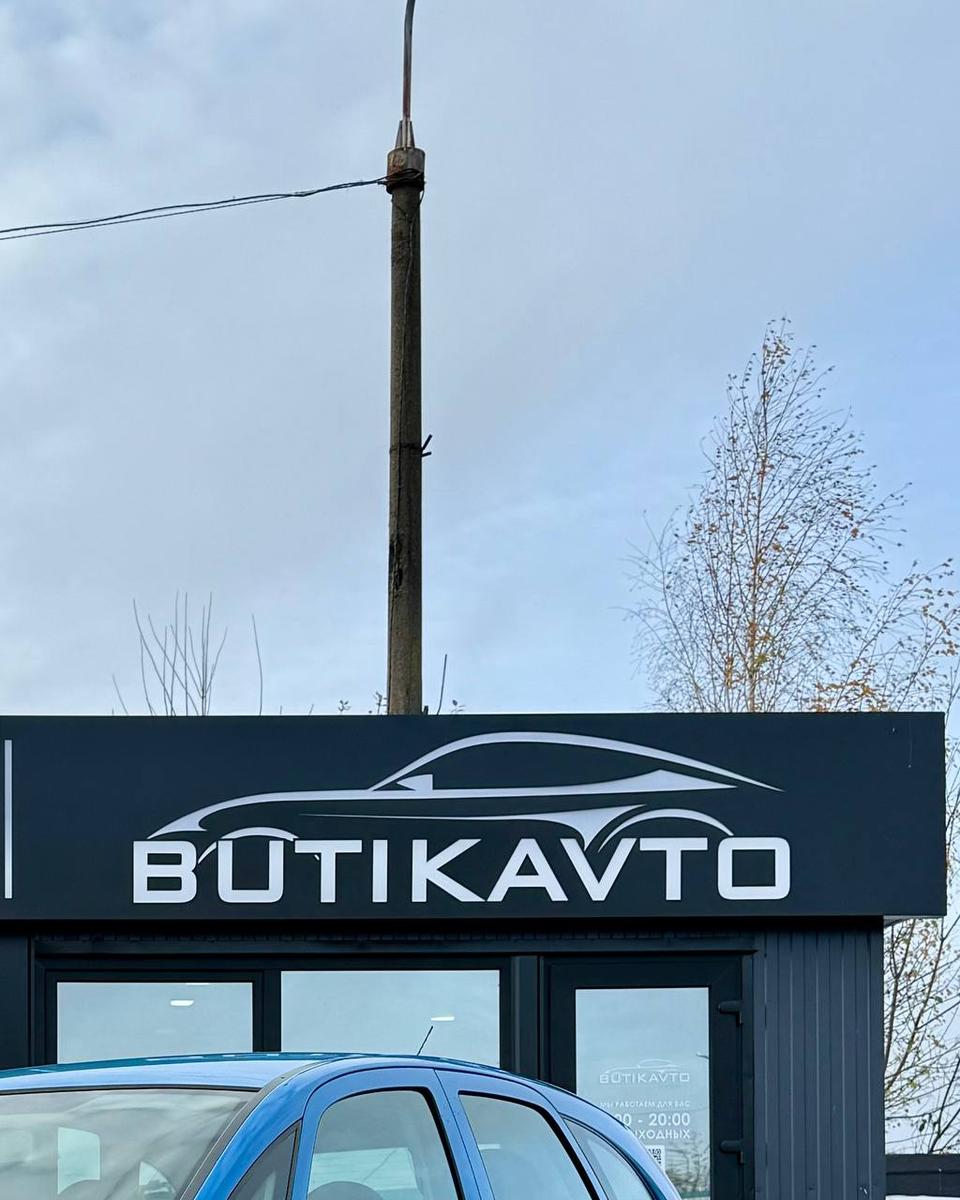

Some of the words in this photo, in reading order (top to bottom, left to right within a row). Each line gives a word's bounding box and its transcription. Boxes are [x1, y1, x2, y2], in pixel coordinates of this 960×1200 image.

[132, 836, 791, 903] BUTIKAVTO
[600, 1073, 690, 1084] BUTIKAVTO
[649, 1113, 690, 1126] 20:00
